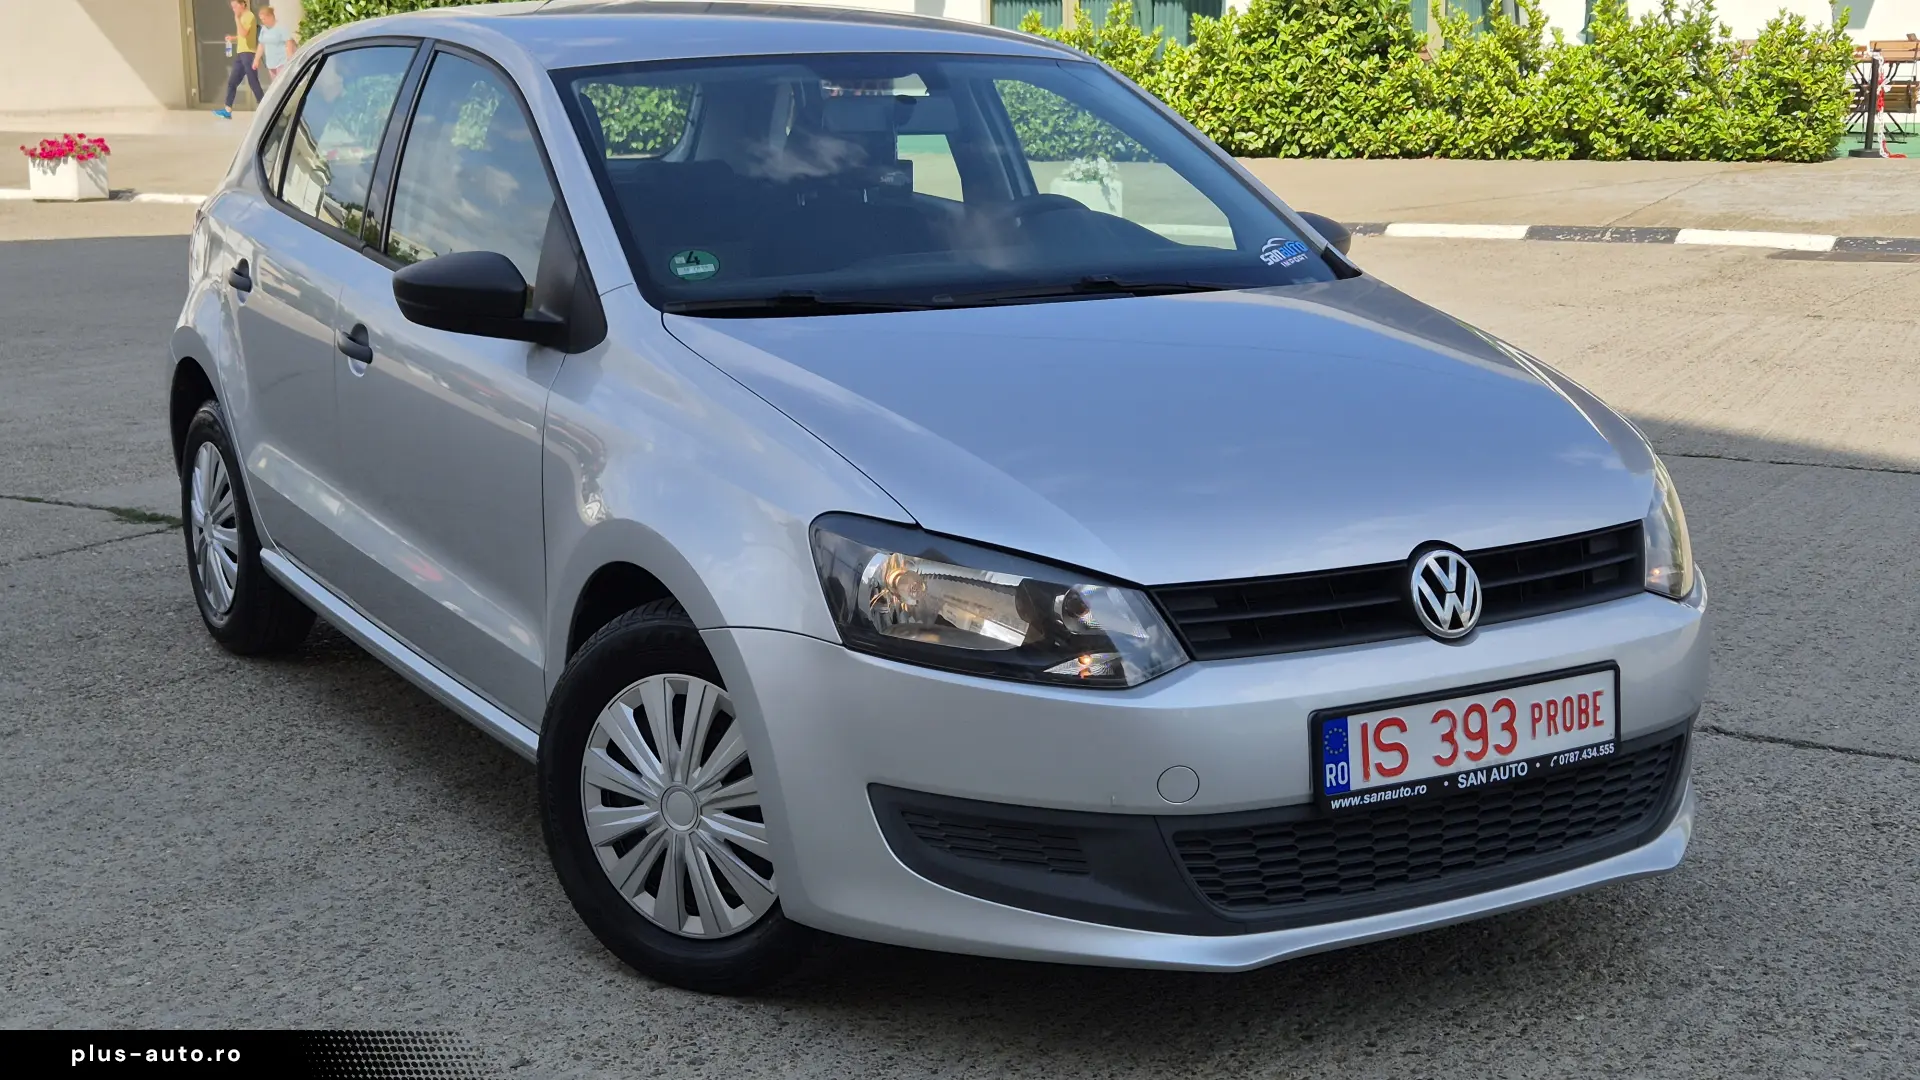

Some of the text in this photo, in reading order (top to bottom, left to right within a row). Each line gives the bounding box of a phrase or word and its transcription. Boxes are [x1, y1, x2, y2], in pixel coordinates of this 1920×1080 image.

[686, 251, 701, 265] 4
[1280, 253, 1308, 267] IMPORT
[1411, 549, 1482, 638] VW
[1360, 690, 1604, 783] IS 393 PROBE
[1325, 761, 1349, 788] RO
[1331, 743, 1615, 810] www.sanauto.ro SAN AUTO 0787.434.555
